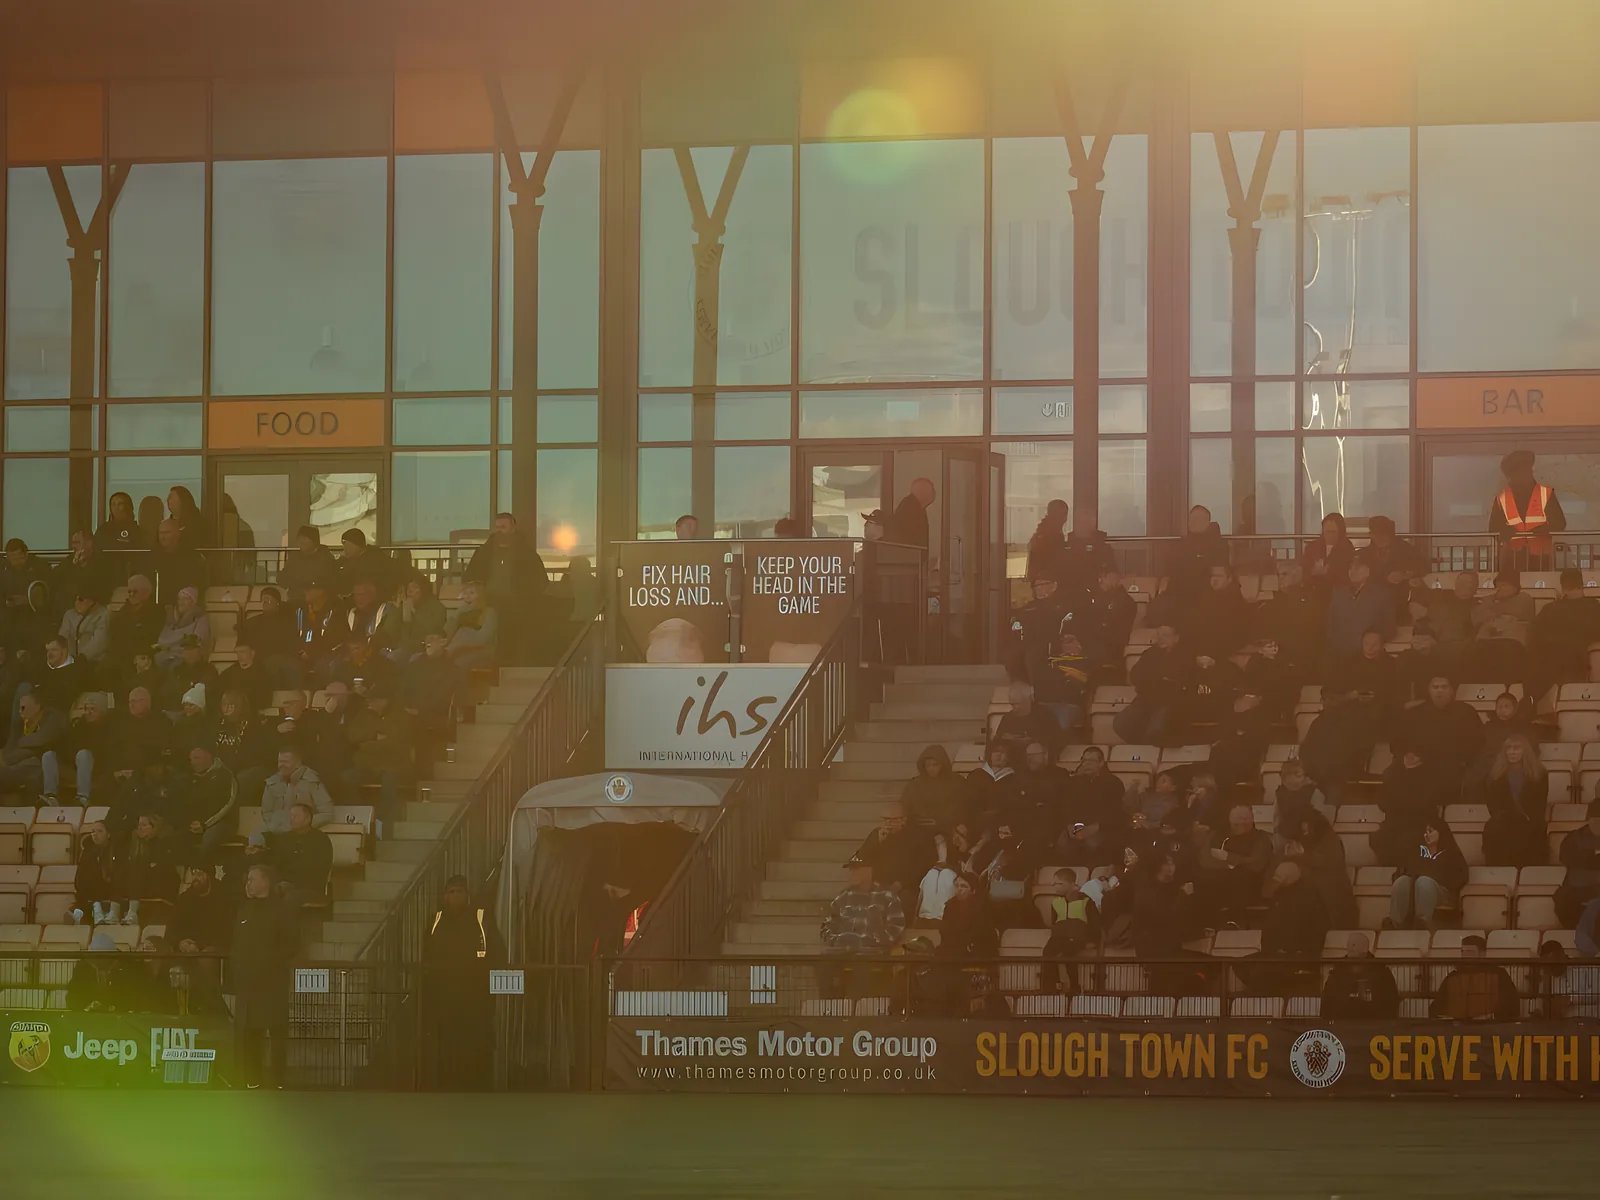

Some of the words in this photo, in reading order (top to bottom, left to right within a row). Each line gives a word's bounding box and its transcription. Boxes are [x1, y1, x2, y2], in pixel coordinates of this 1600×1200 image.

[1482, 389, 1544, 415] BAR
[256, 411, 339, 436] FOOD
[642, 564, 667, 585] FIX
[671, 564, 711, 585] HAIR
[757, 556, 795, 575] KEEP
[799, 556, 842, 575] YOUR
[629, 587, 671, 607] LOSS
[675, 586, 724, 606] AND...
[752, 576, 793, 595] HEAD
[798, 576, 813, 594] IN
[817, 576, 846, 594] THE
[778, 596, 820, 614] GAME
[676, 671, 777, 738] ihs
[639, 751, 737, 762] INTERNATIONAL
[63, 1031, 138, 1065] Jeep
[636, 1030, 747, 1057] Thames
[758, 1030, 844, 1057] Motor
[852, 1030, 937, 1063] Group
[976, 1031, 1109, 1078] SLOUGH
[1119, 1033, 1216, 1079] TOWN
[1227, 1033, 1269, 1080] FC
[1369, 1034, 1481, 1081] SERVE
[1493, 1035, 1578, 1081] WITH
[636, 1064, 937, 1082] www.thamesmotorgroup.co.uk
